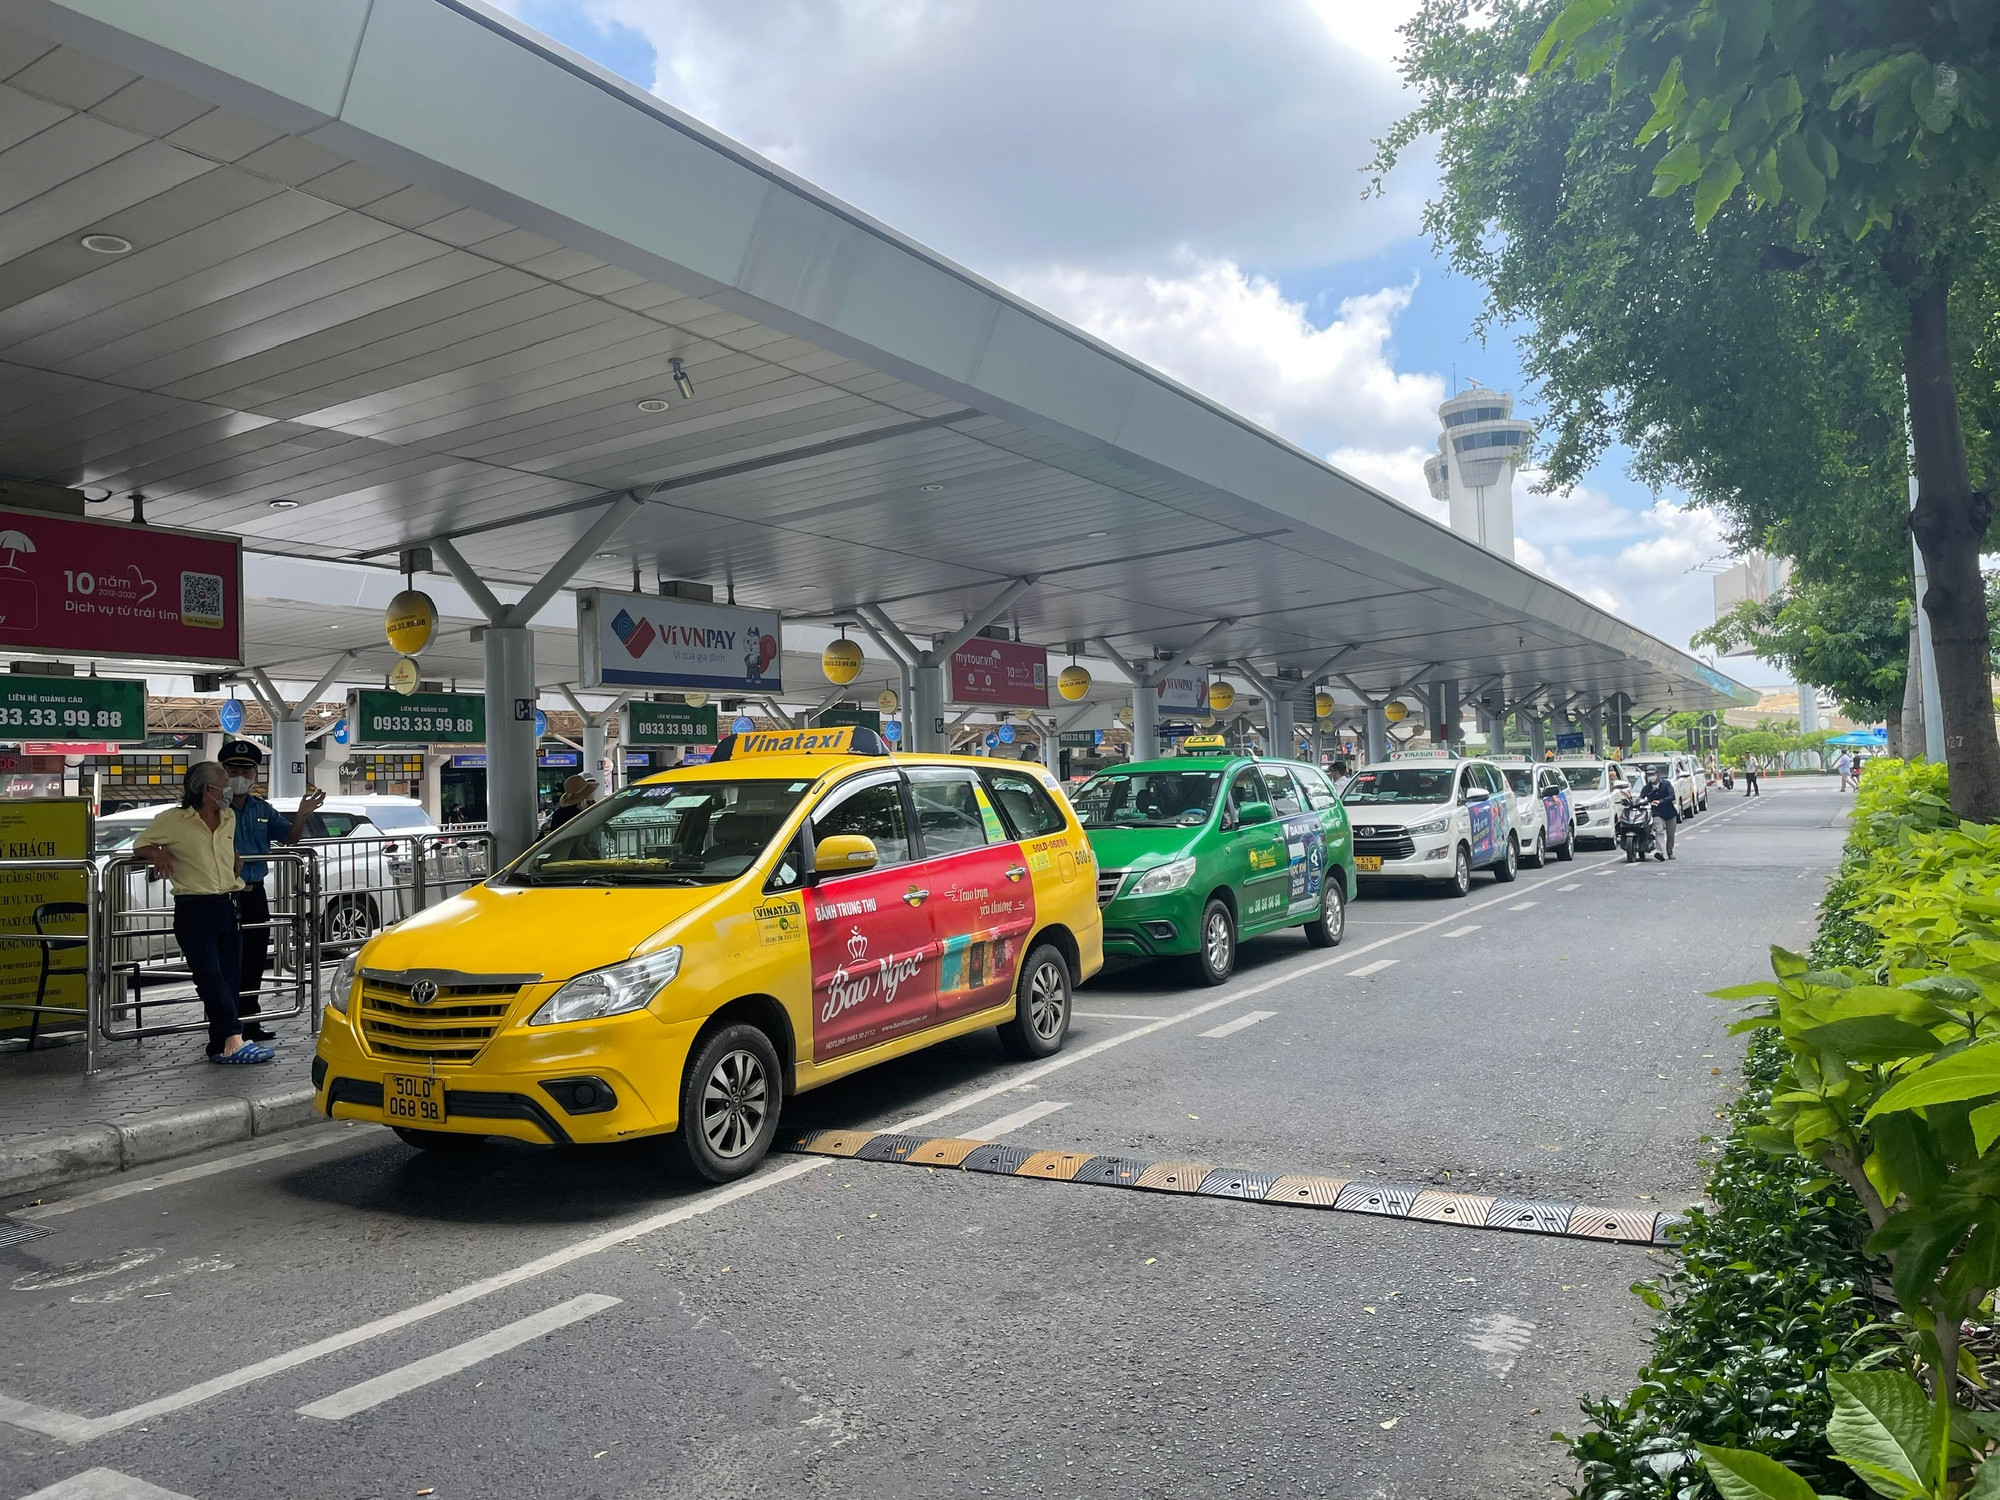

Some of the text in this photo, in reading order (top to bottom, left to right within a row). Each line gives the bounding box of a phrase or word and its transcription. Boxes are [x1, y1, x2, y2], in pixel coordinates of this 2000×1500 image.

[64, 570, 130, 594] 10 năm
[99, 589, 136, 598] 2012-2022
[66, 601, 178, 620] Dịch vụ từ trái tim
[659, 624, 736, 650] Ví VNPAY
[697, 652, 708, 664] gia
[956, 653, 994, 666] mytour.vn
[1007, 667, 1015, 678] 10
[28, 694, 37, 702] HỆ
[40, 694, 66, 703] QUẢNG
[374, 716, 474, 732] 0933.33.99.88
[640, 723, 708, 735] 0933.33.99.88
[335, 730, 344, 738] VIB
[744, 731, 844, 752] Vinataxi
[1290, 824, 1310, 836] DAIKIN
[10, 838, 56, 858] KHÁCH
[958, 888, 988, 902] Trao trọn
[757, 904, 798, 918] VINATAXI
[815, 898, 877, 921] BÁNH TRUNG THU
[2, 917, 20, 927] TAXI
[396, 1078, 430, 1098] 50LD
[390, 1097, 438, 1120] 068 98
